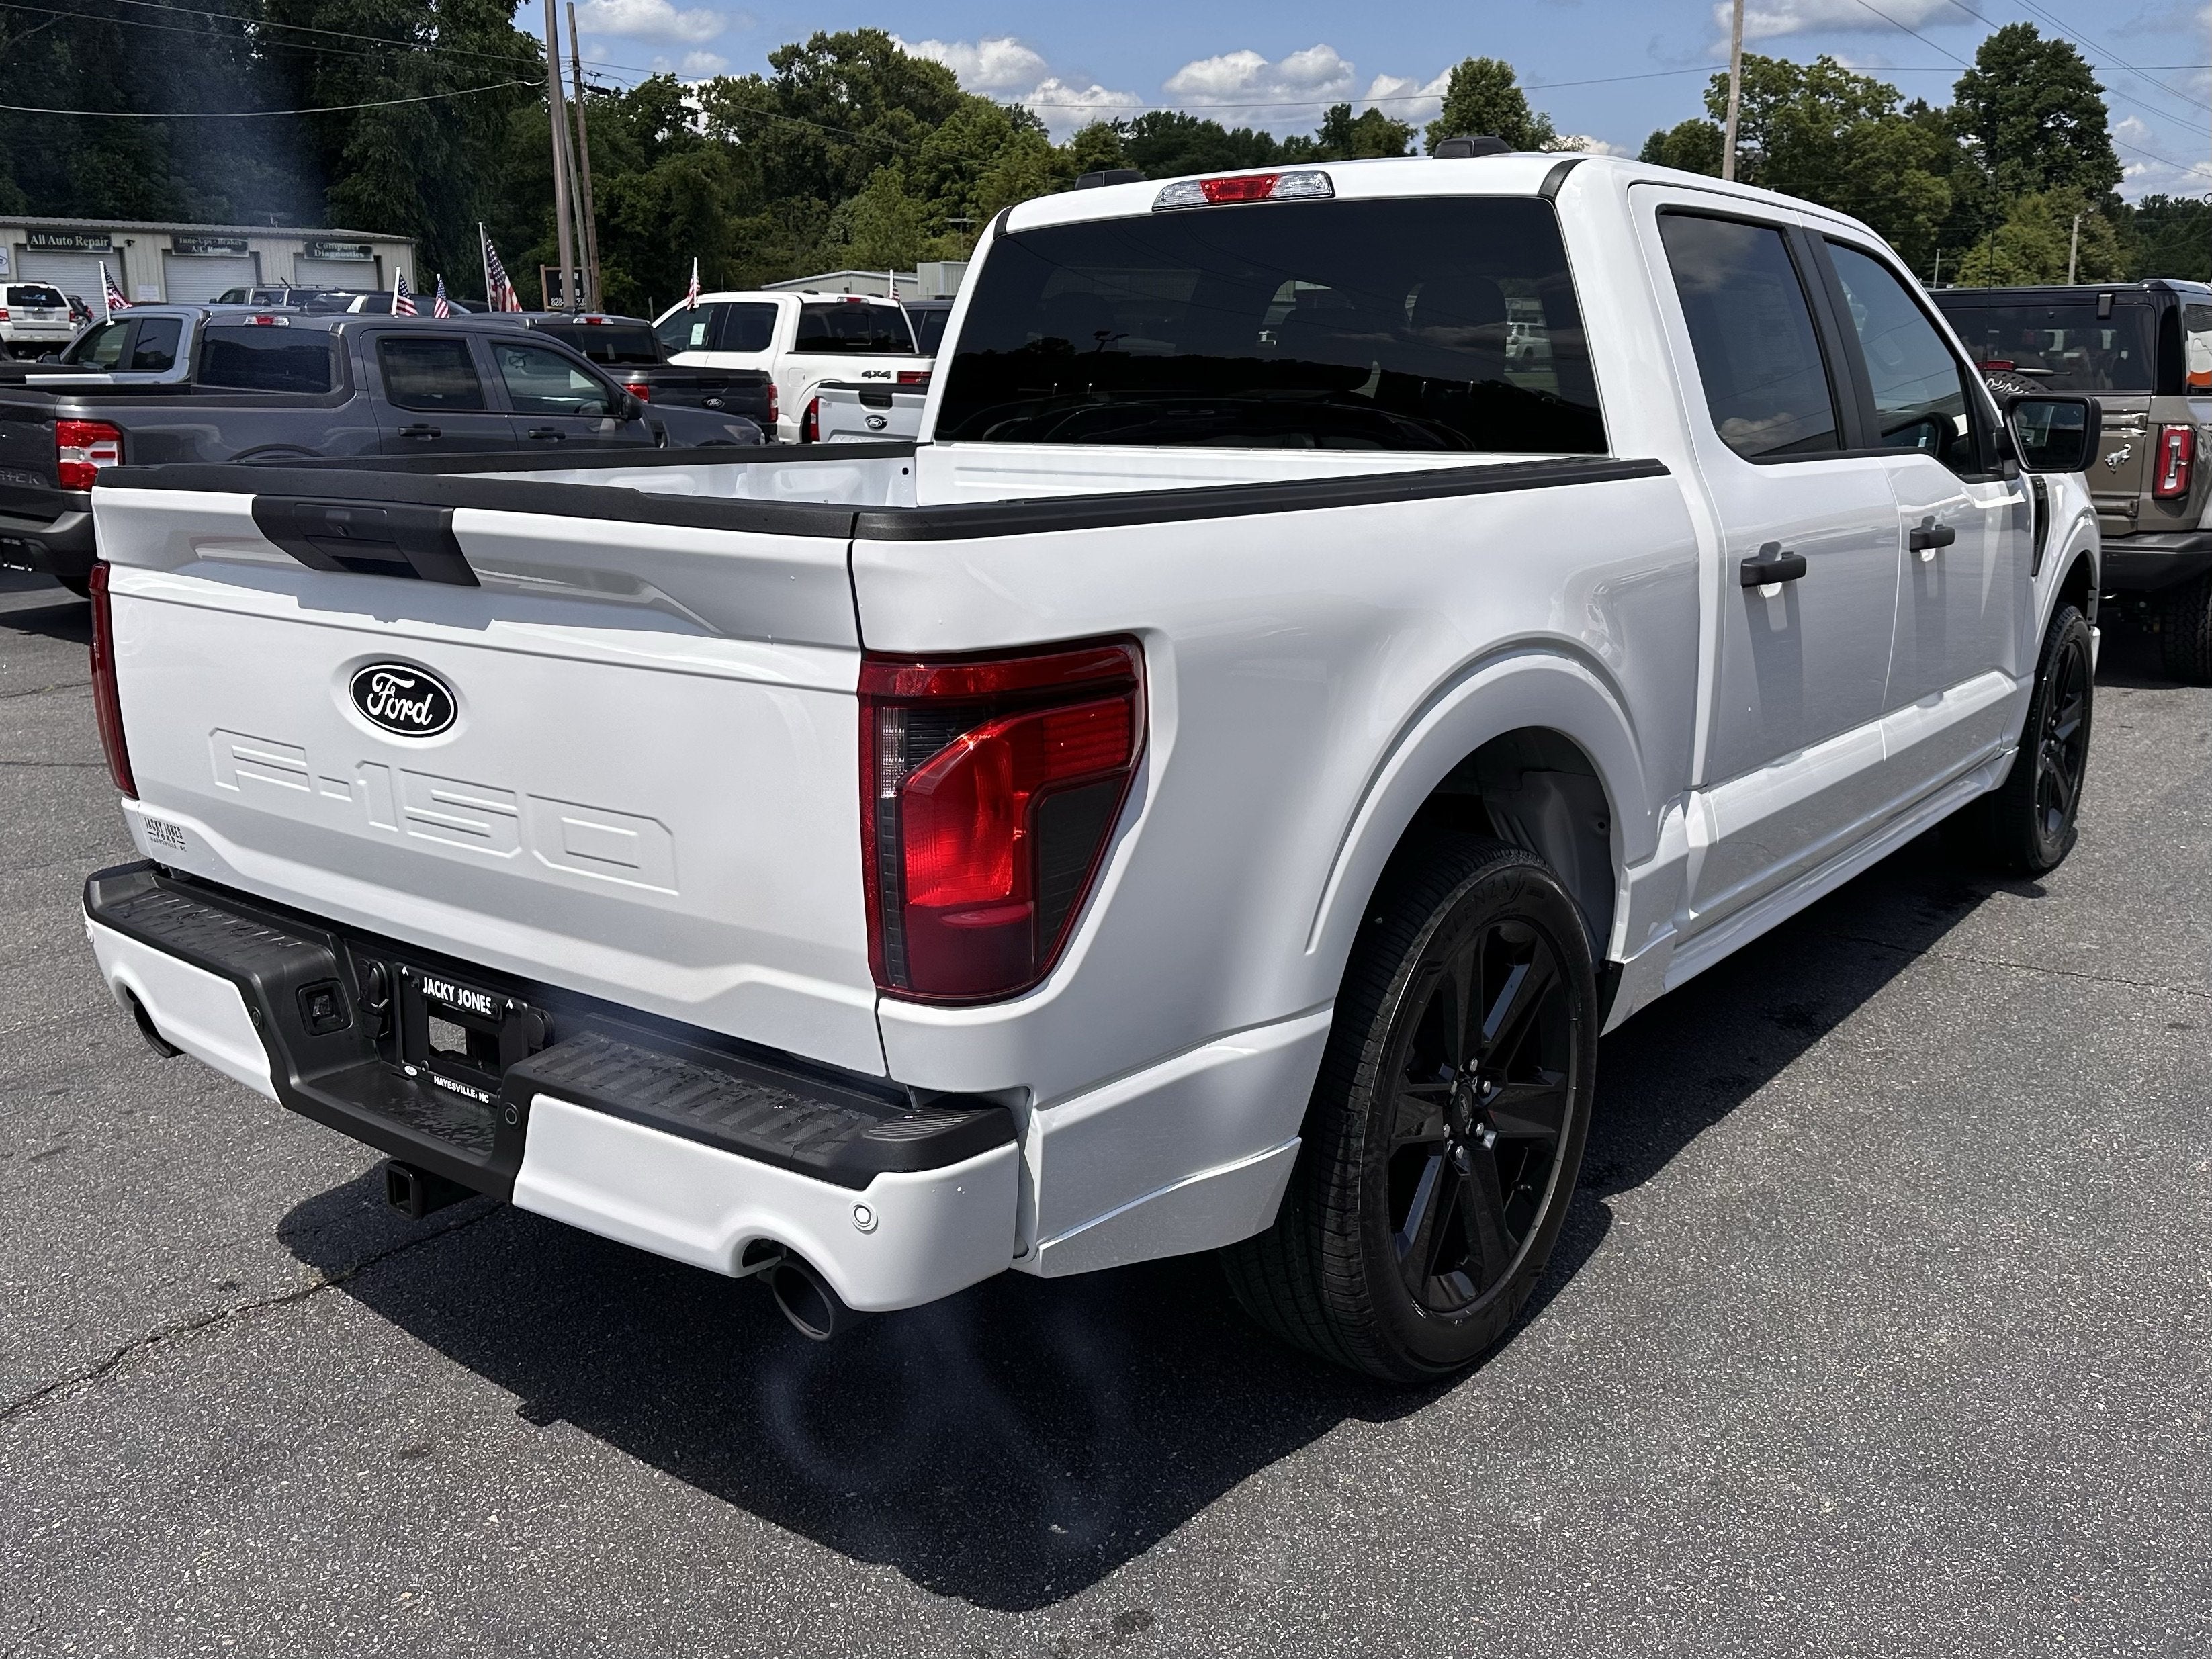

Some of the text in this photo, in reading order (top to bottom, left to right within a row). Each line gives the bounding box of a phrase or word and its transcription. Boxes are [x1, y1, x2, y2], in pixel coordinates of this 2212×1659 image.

[30, 234, 109, 249] All Auto Repair
[315, 242, 359, 251] Computer
[314, 249, 364, 258] Diagnostics
[367, 672, 434, 725] Ford
[208, 727, 680, 896] F-150
[144, 817, 183, 840] JACKY JONES
[155, 832, 176, 843] FORD
[423, 977, 492, 1015] JACKY JONES
[478, 1092, 489, 1104] NC
